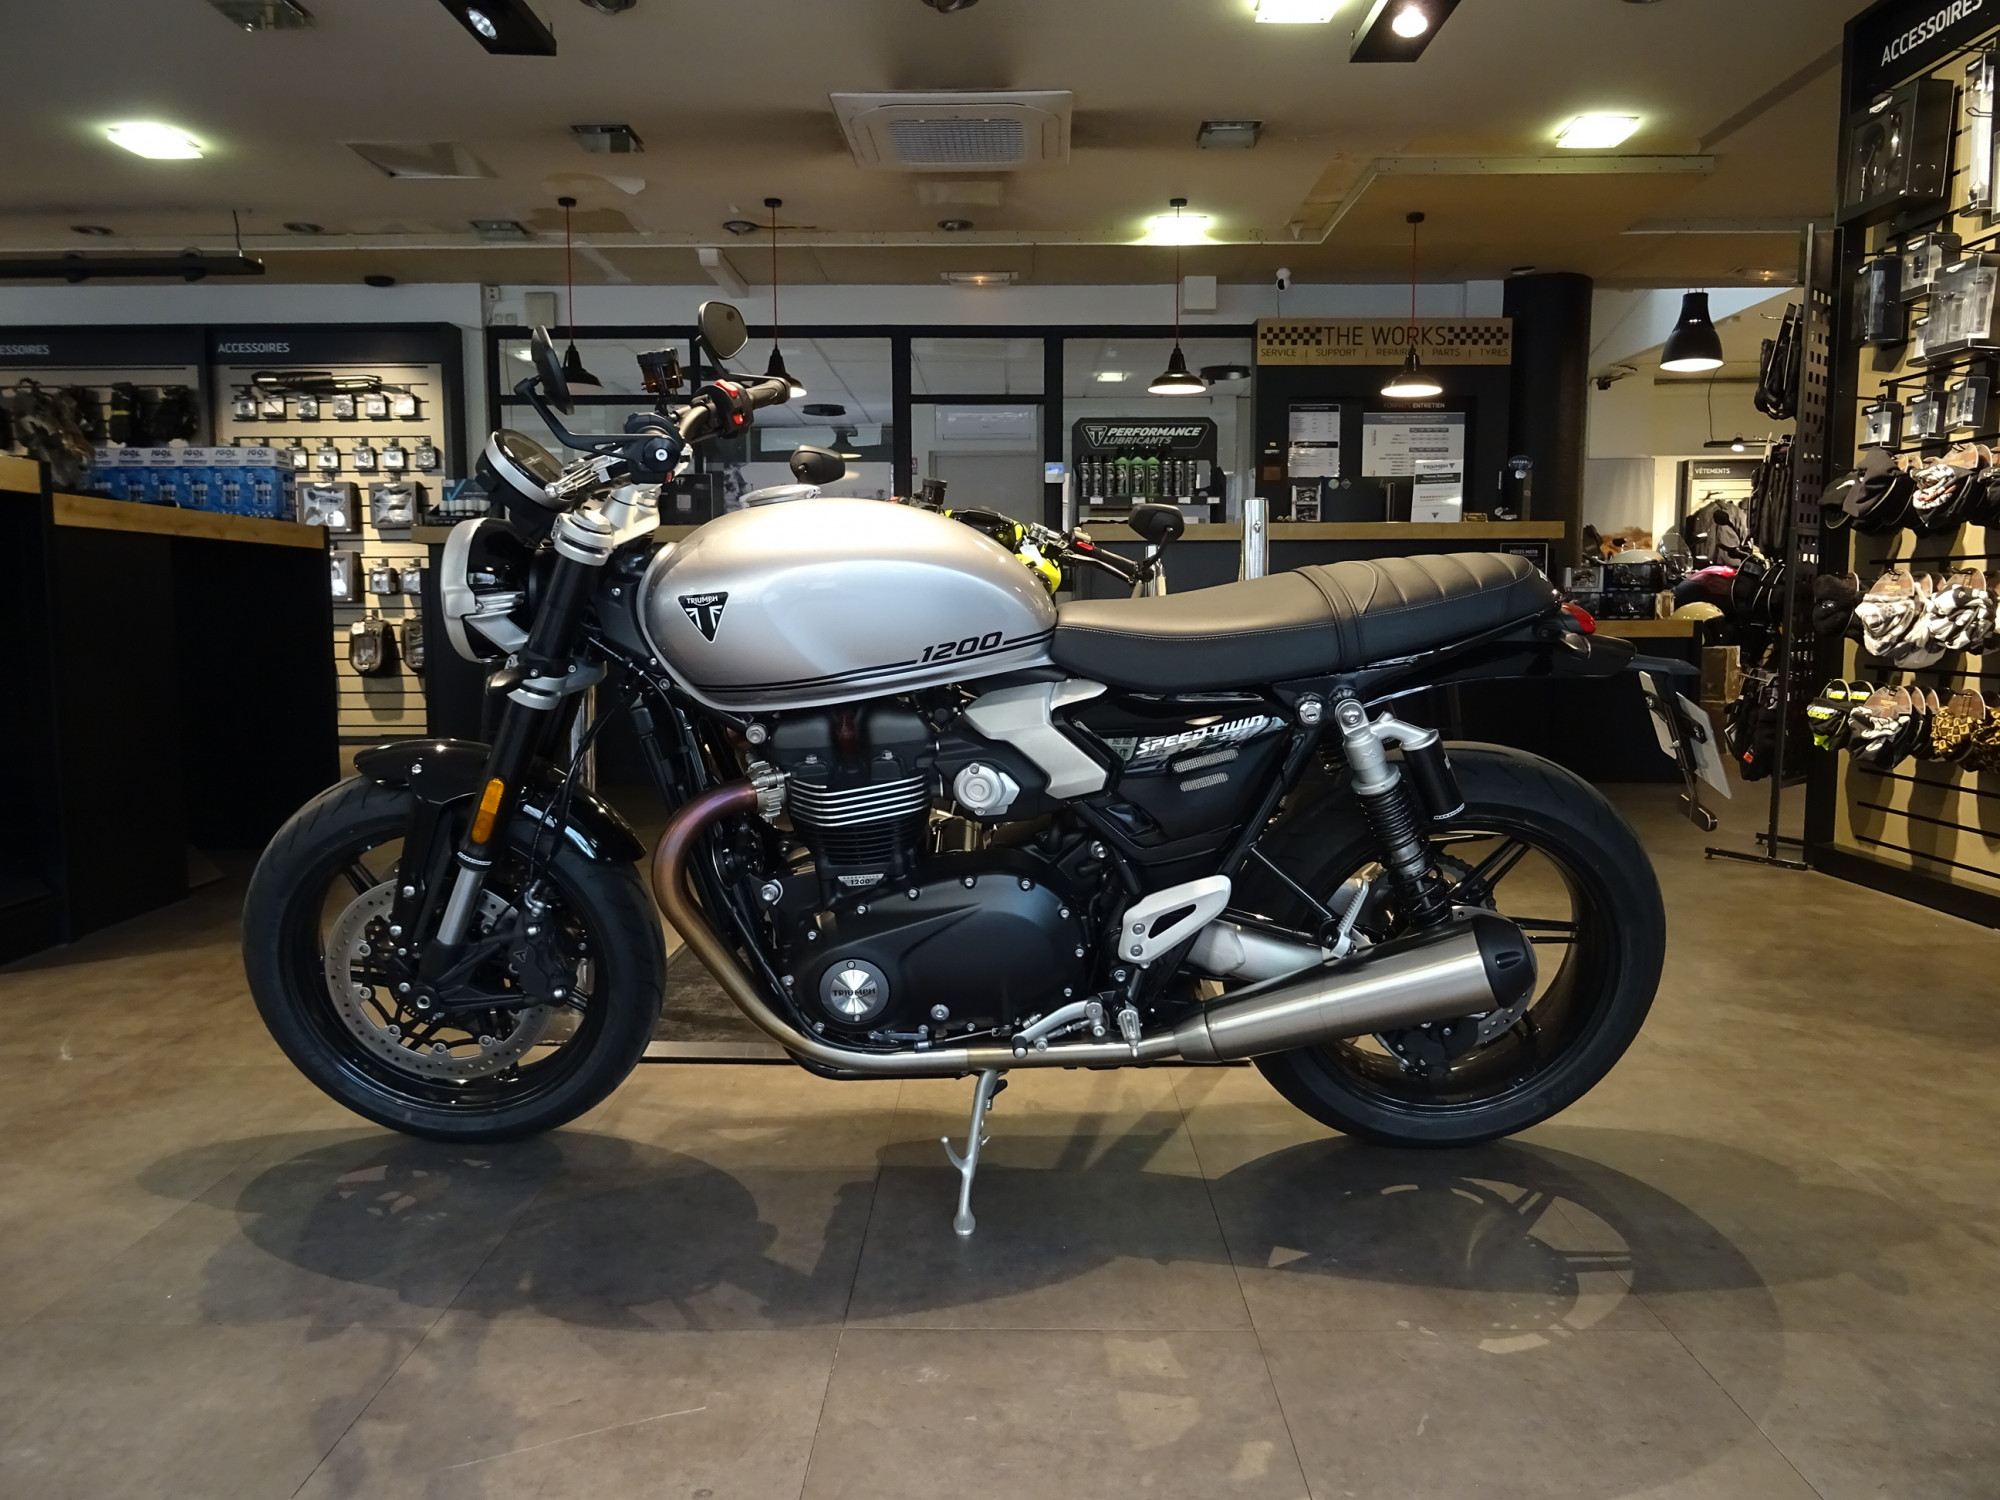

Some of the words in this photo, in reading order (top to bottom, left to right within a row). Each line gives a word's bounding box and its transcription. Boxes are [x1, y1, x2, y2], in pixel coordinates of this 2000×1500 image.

[1324, 326, 1363, 346] THE
[1371, 326, 1446, 346] WORKS
[217, 342, 290, 353] ACCESSOIRES
[1260, 348, 1297, 357] SERVICE
[1315, 348, 1357, 357] SUPPORT
[1432, 348, 1461, 357] PARTS
[1480, 348, 1509, 357] TYRES
[1107, 427, 1202, 436] PERFORMANCE
[1103, 436, 1172, 445] LUBRICANTS
[686, 595, 719, 605] TRIUMPH
[921, 631, 1003, 663] 1200
[832, 988, 877, 998] TRIUMPH
